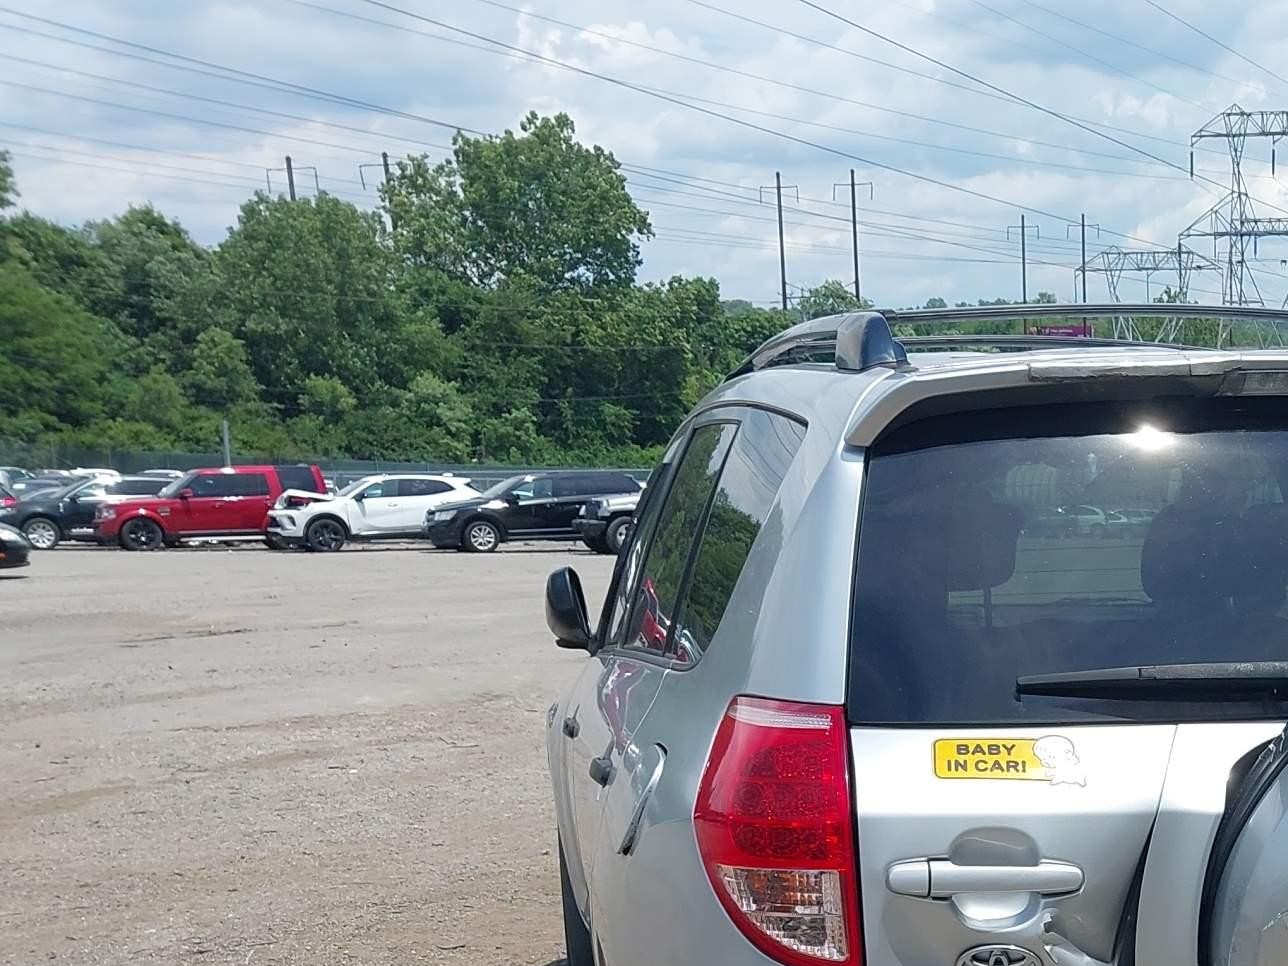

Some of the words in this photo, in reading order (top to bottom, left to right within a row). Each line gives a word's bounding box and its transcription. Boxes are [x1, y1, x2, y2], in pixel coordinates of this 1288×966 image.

[956, 743, 1016, 756] BABY
[946, 759, 968, 773] IN
[974, 759, 1027, 773] CAR!
